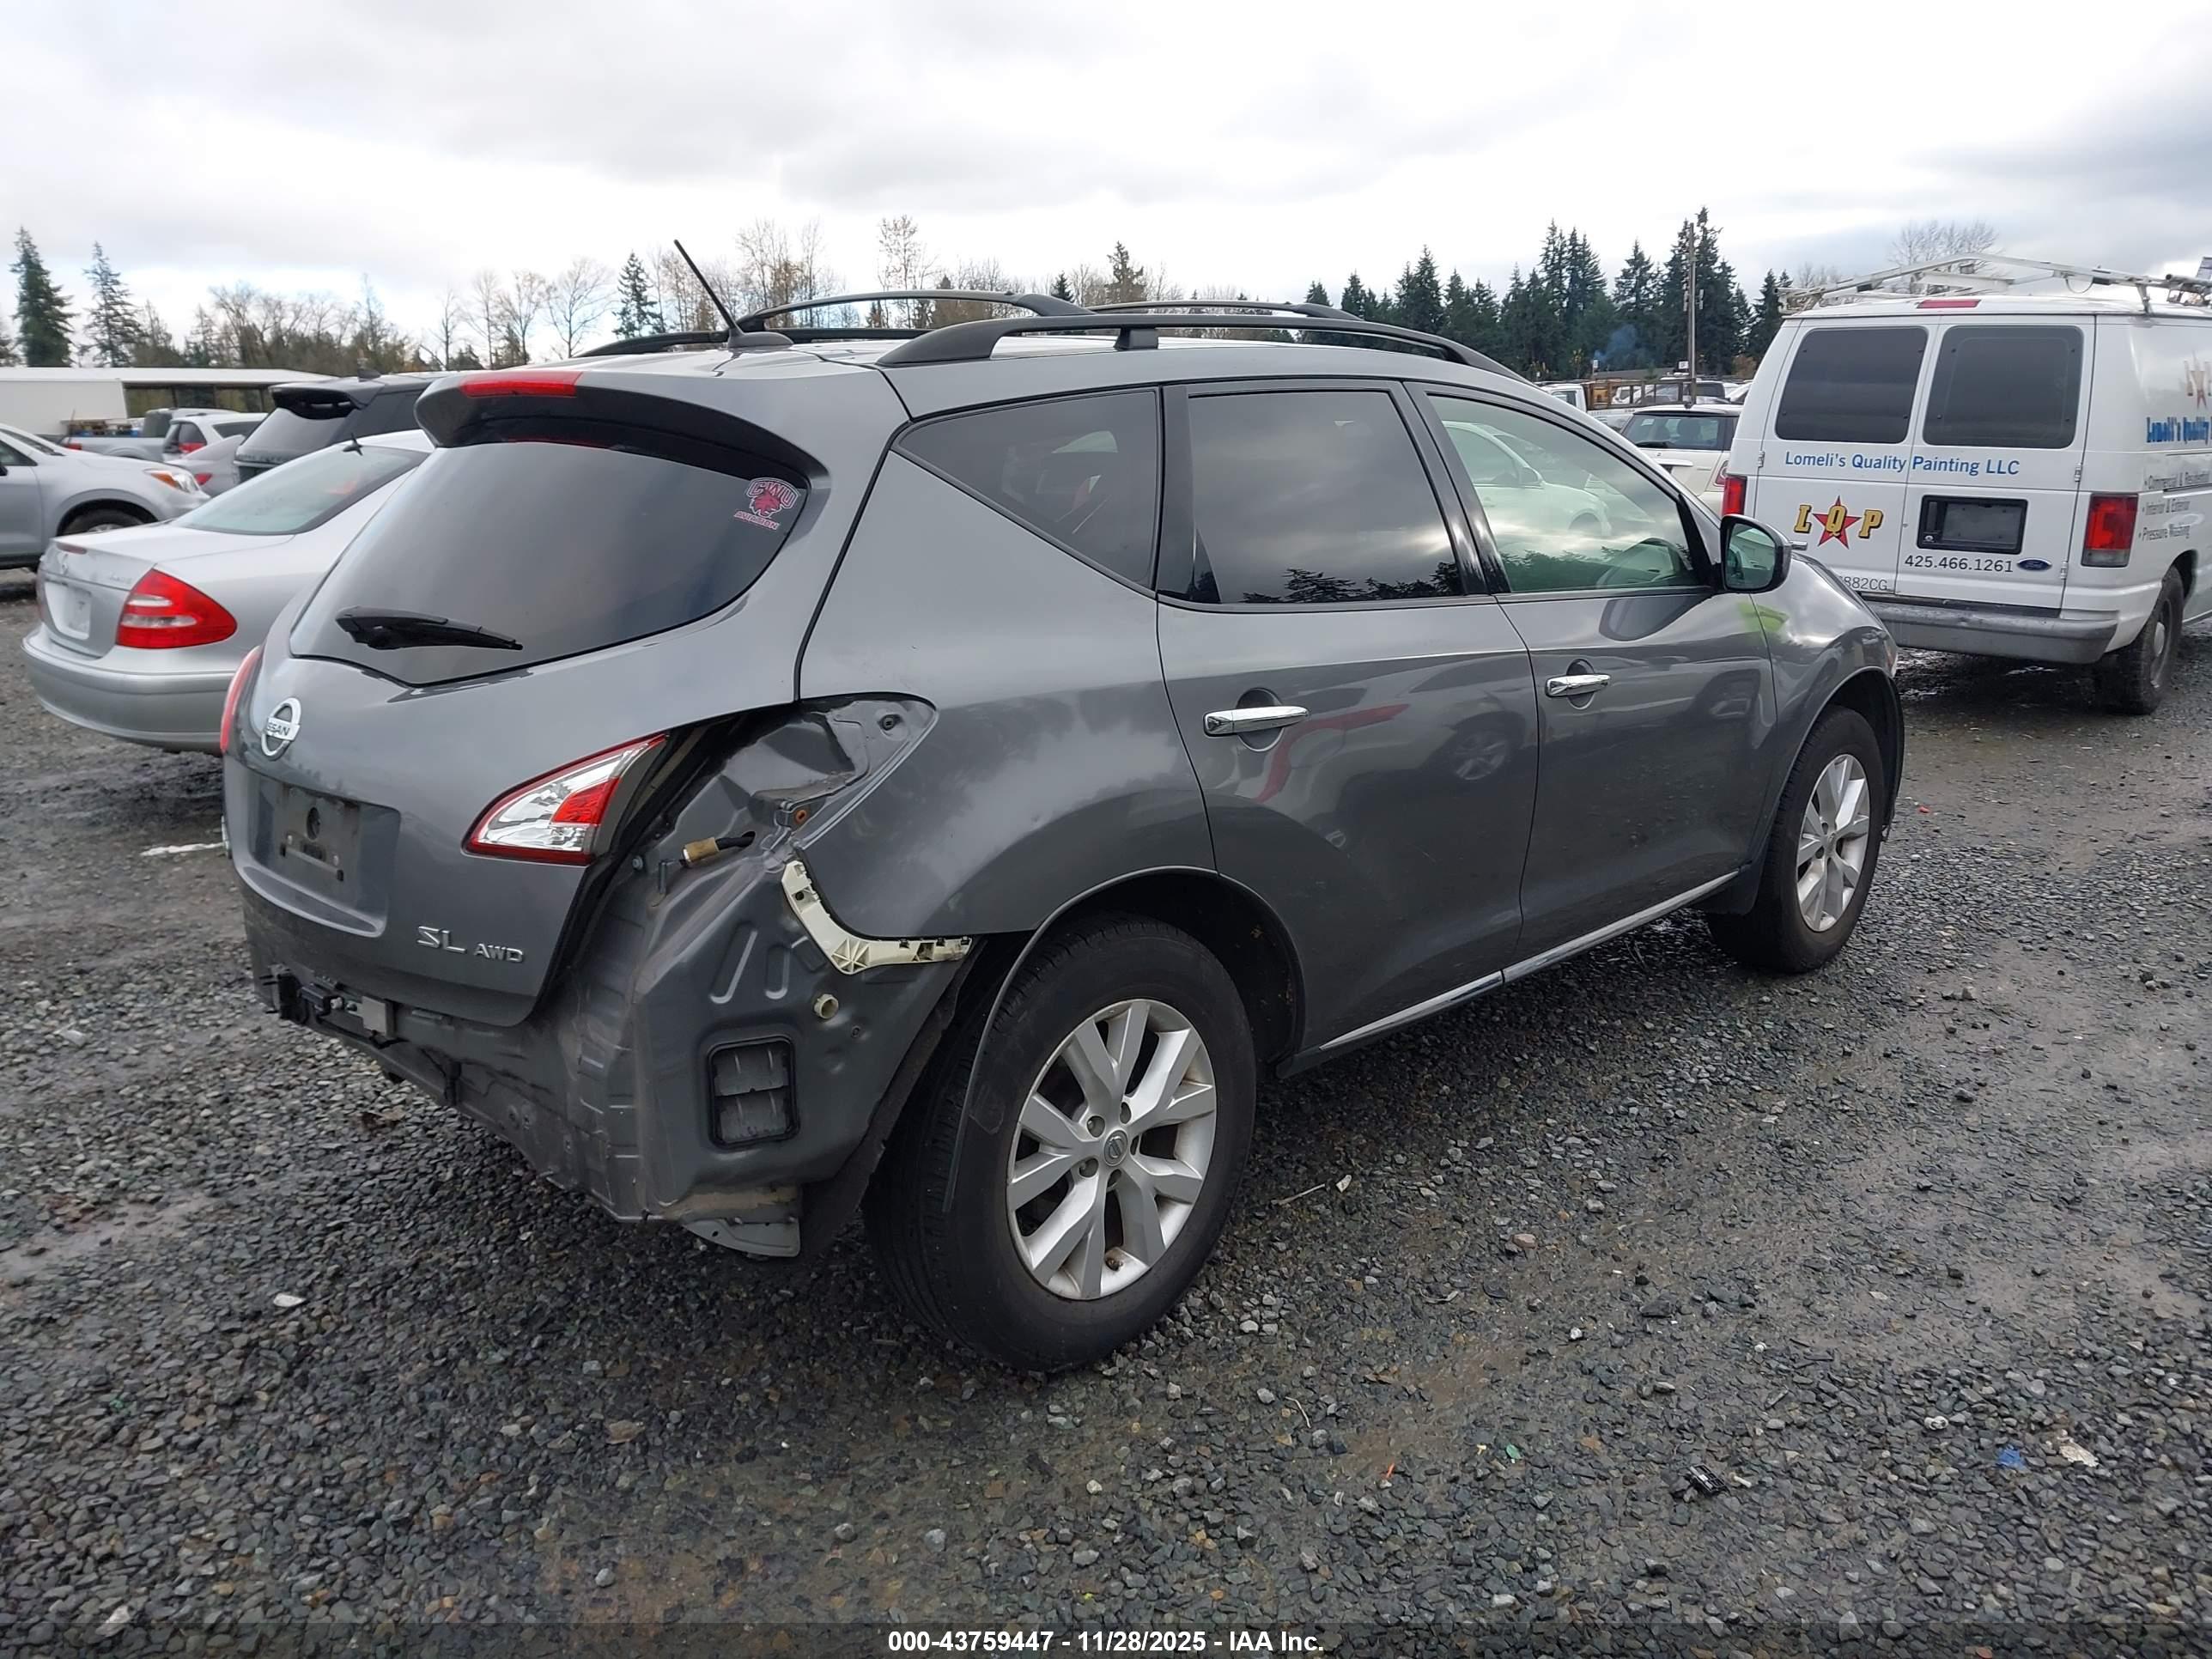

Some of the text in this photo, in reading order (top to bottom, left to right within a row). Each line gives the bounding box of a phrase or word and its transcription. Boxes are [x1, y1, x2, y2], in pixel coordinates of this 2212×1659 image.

[1785, 451, 2021, 476] Lomeli's Quality Painting LLC
[747, 479, 797, 508] CWU
[1905, 555, 2014, 573] 425.466.1261
[1840, 576, 1888, 591] 882CG
[417, 926, 524, 962] SL AWD
